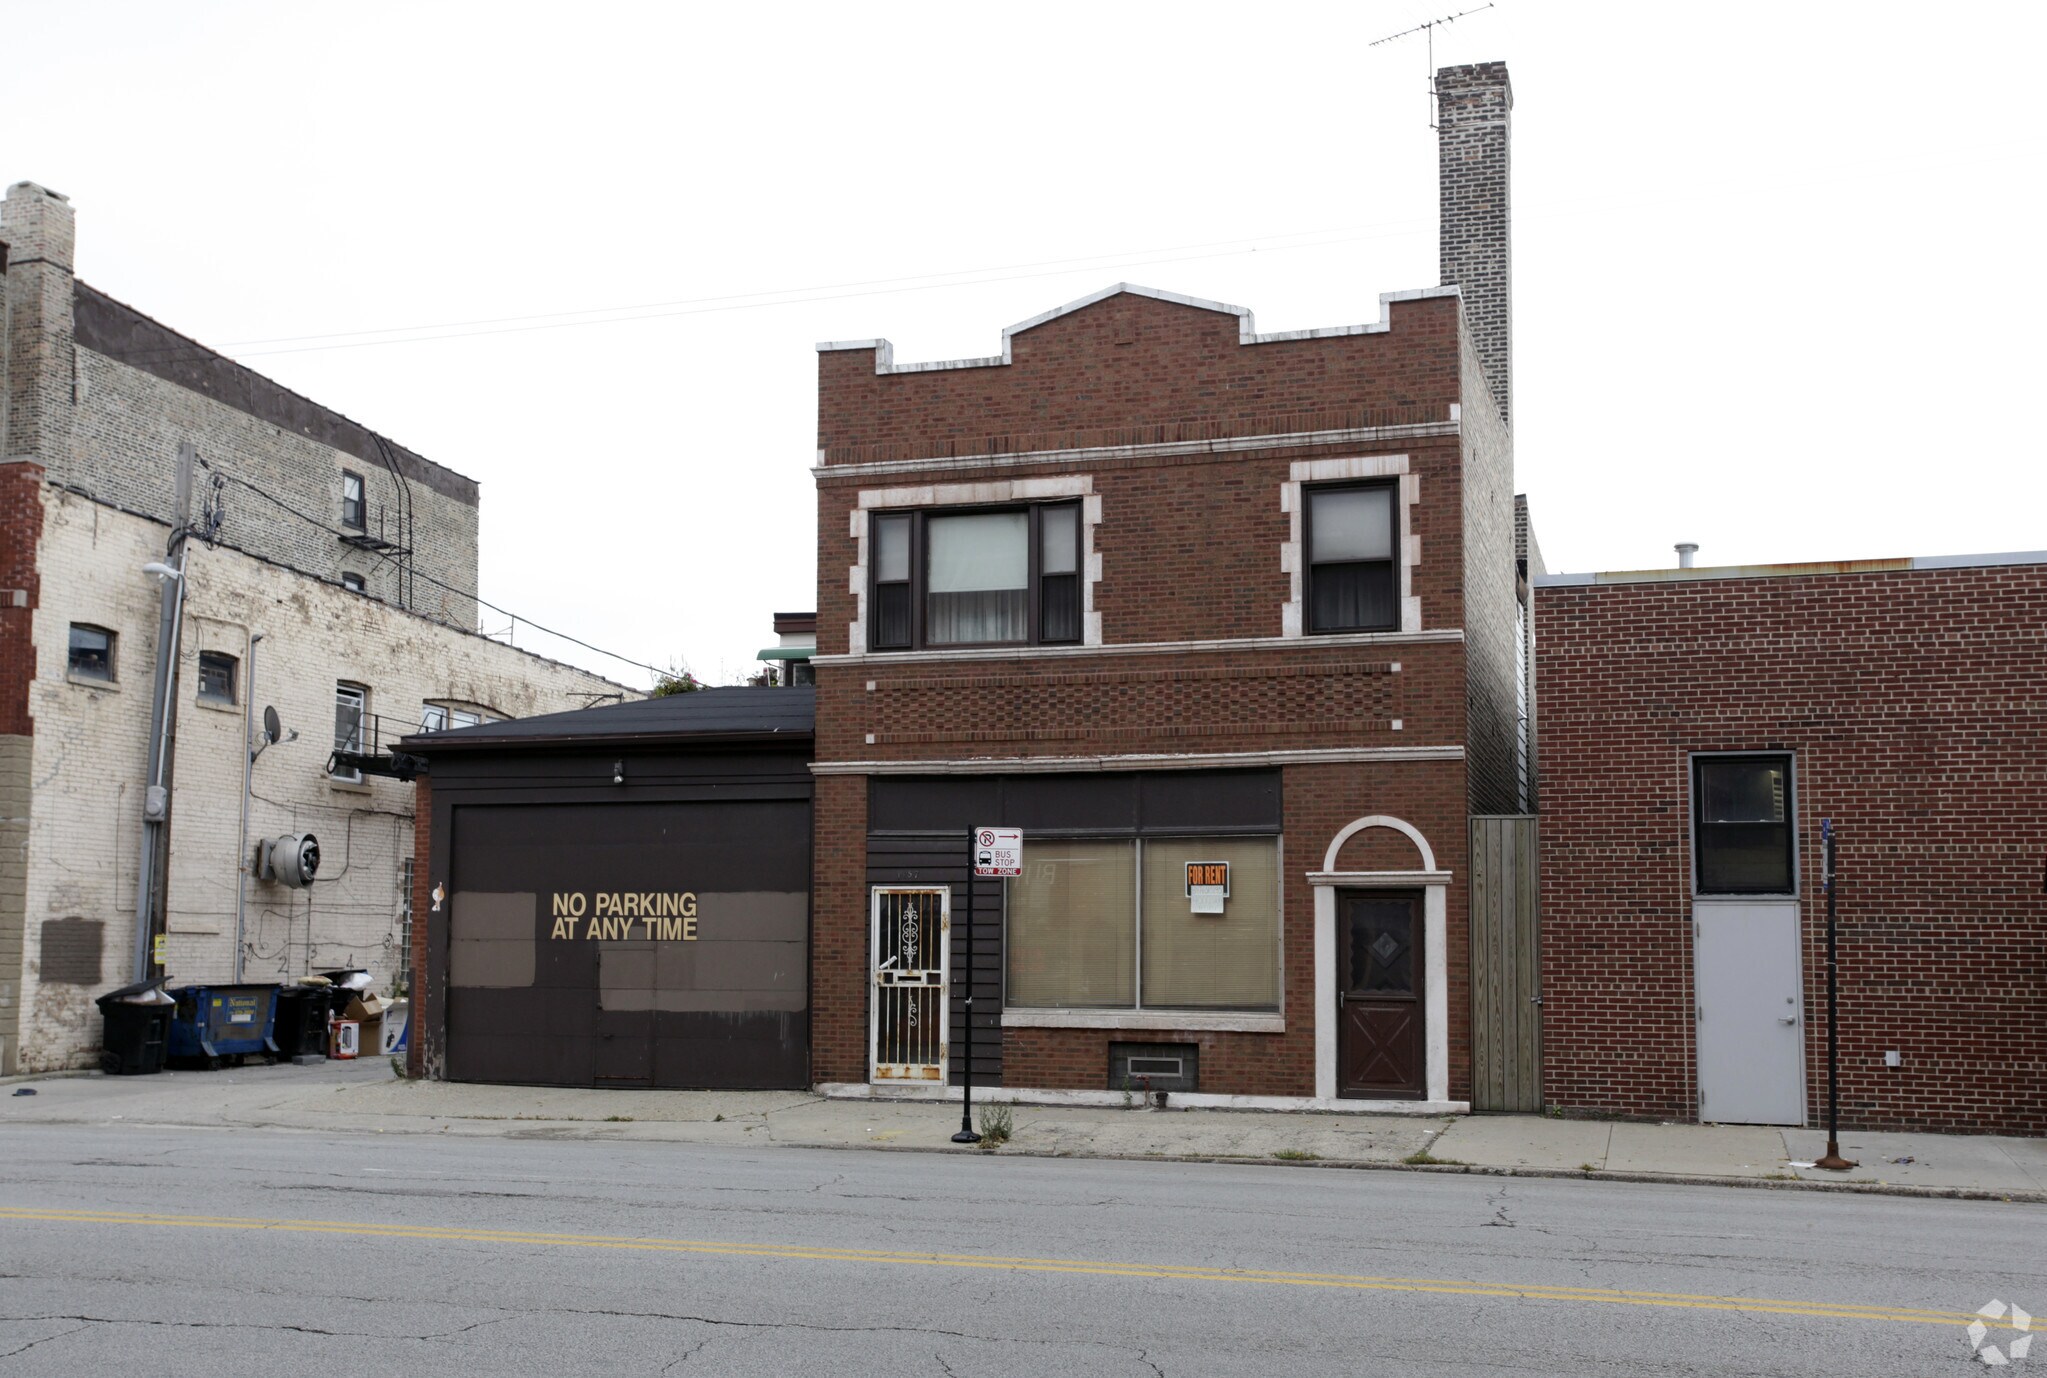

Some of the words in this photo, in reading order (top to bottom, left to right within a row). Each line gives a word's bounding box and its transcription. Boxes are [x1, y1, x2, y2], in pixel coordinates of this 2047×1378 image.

[995, 850, 1011, 858] BUS
[1188, 865, 1204, 885] FOR
[1205, 865, 1225, 885] RENT
[552, 892, 587, 917] NO
[595, 892, 697, 917] PARKING
[551, 917, 579, 940] AT
[586, 917, 634, 940] ANY
[642, 917, 698, 941] TIME
[277, 955, 288, 973] 2
